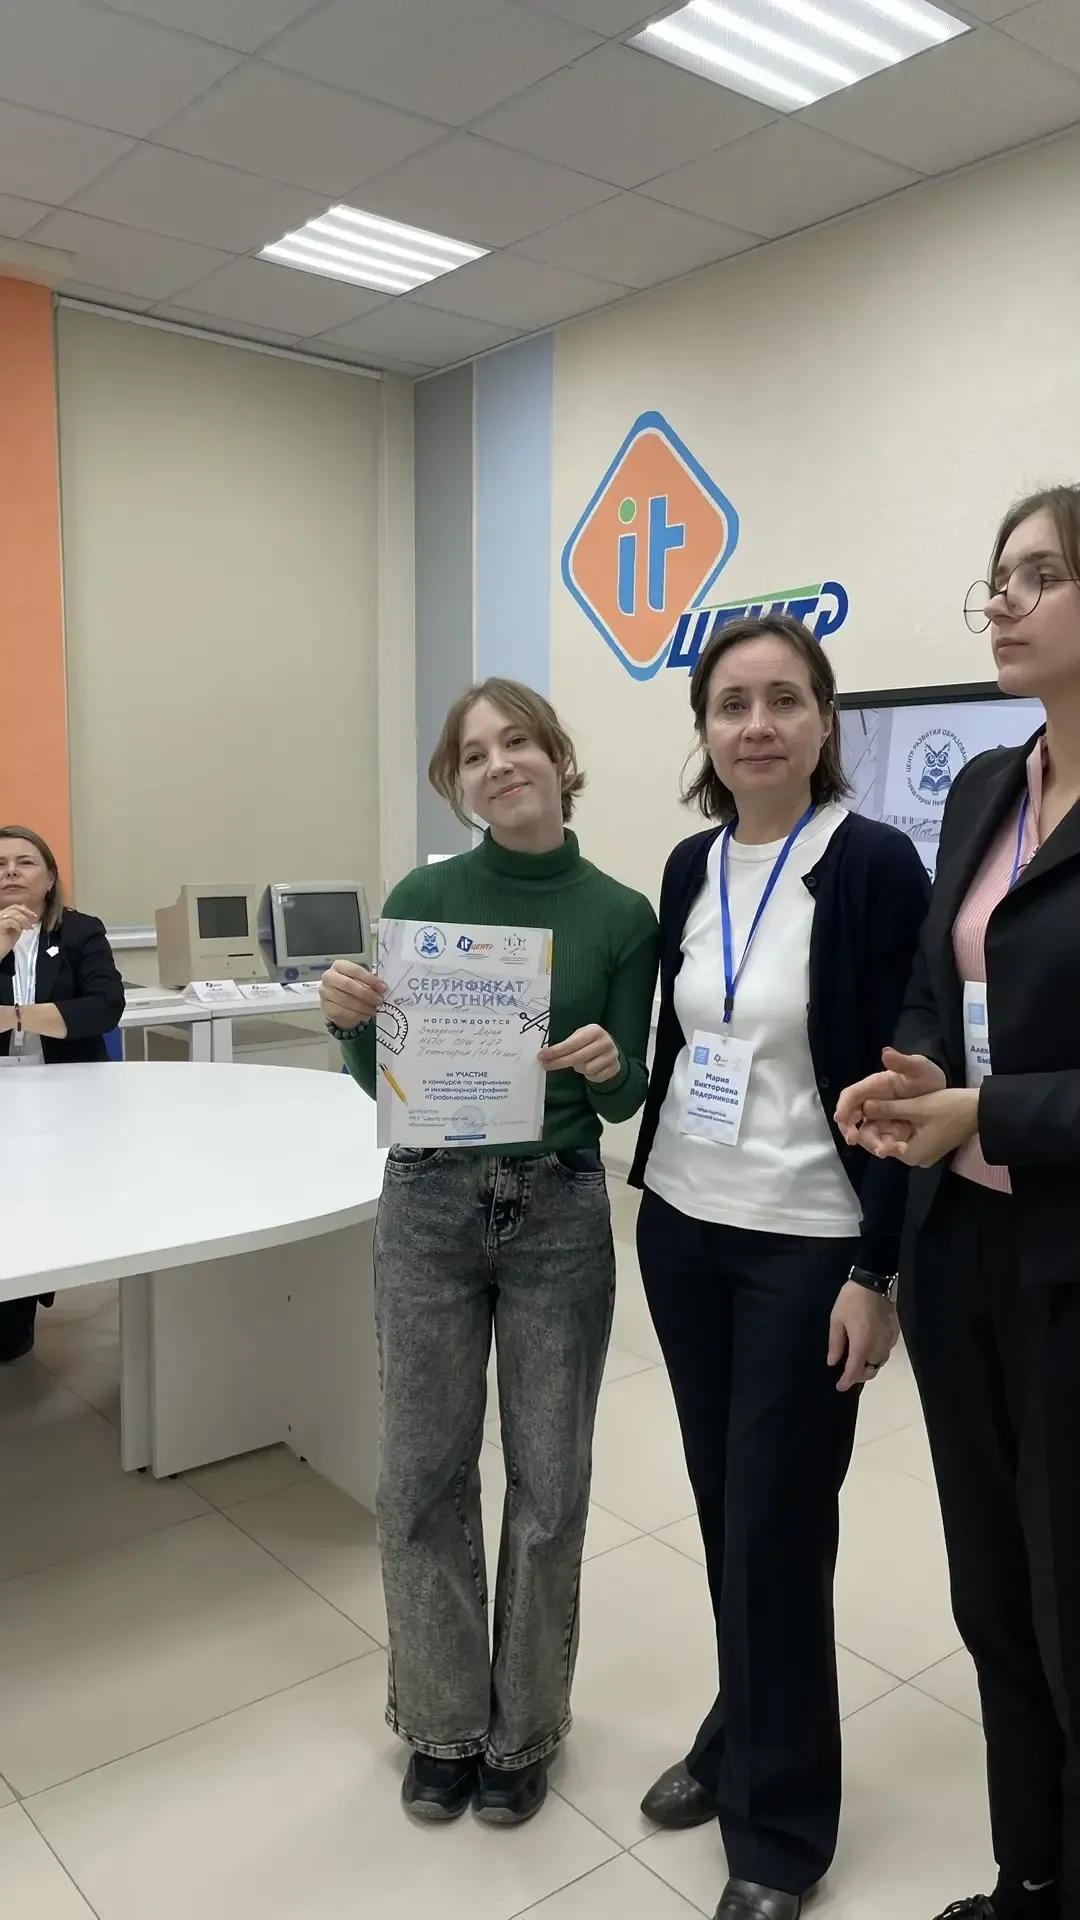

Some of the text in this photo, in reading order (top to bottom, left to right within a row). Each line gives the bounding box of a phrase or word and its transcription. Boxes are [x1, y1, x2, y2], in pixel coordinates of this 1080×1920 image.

[617, 495, 685, 616] it
[906, 750, 914, 772] ЦЕНТР
[913, 728, 941, 750] РАЗВИТИЯ
[407, 977, 525, 993] СЕРТИФИКАТ
[412, 992, 518, 1007] УЧАСТНИКА
[423, 1017, 510, 1026] награждается
[705, 1072, 730, 1084] Мария
[694, 1079, 738, 1096] Викторовна
[690, 1088, 739, 1105] Ведерникова
